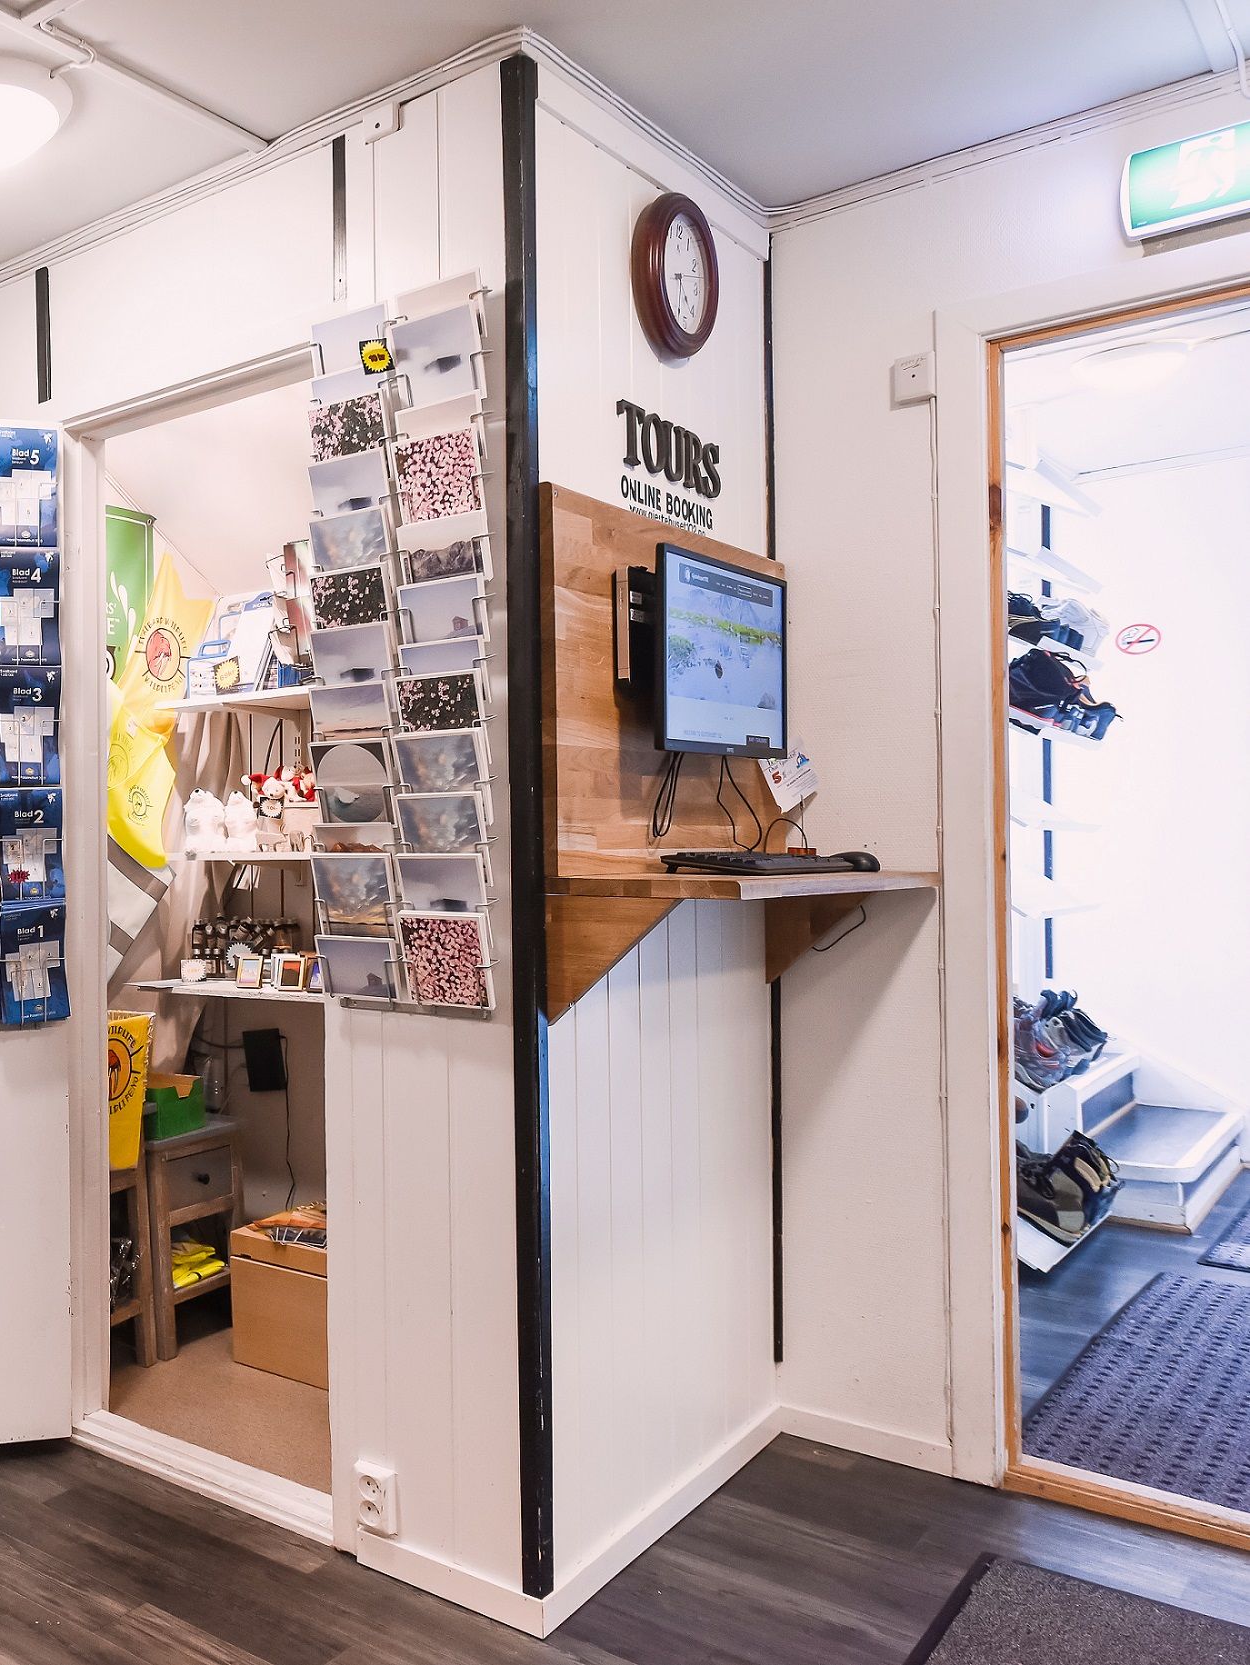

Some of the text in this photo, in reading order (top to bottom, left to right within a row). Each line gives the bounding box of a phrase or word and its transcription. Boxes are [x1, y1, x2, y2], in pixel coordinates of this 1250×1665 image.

[616, 399, 721, 499] TOURS
[12, 449, 30, 457] Blad
[30, 449, 40, 466] 5
[621, 475, 713, 531] ONLINE BOOKING
[12, 568, 30, 576] Blad
[31, 567, 42, 583] 4
[32, 687, 43, 702] 3
[34, 809, 45, 824] 2
[17, 925, 44, 938] Blad 1
